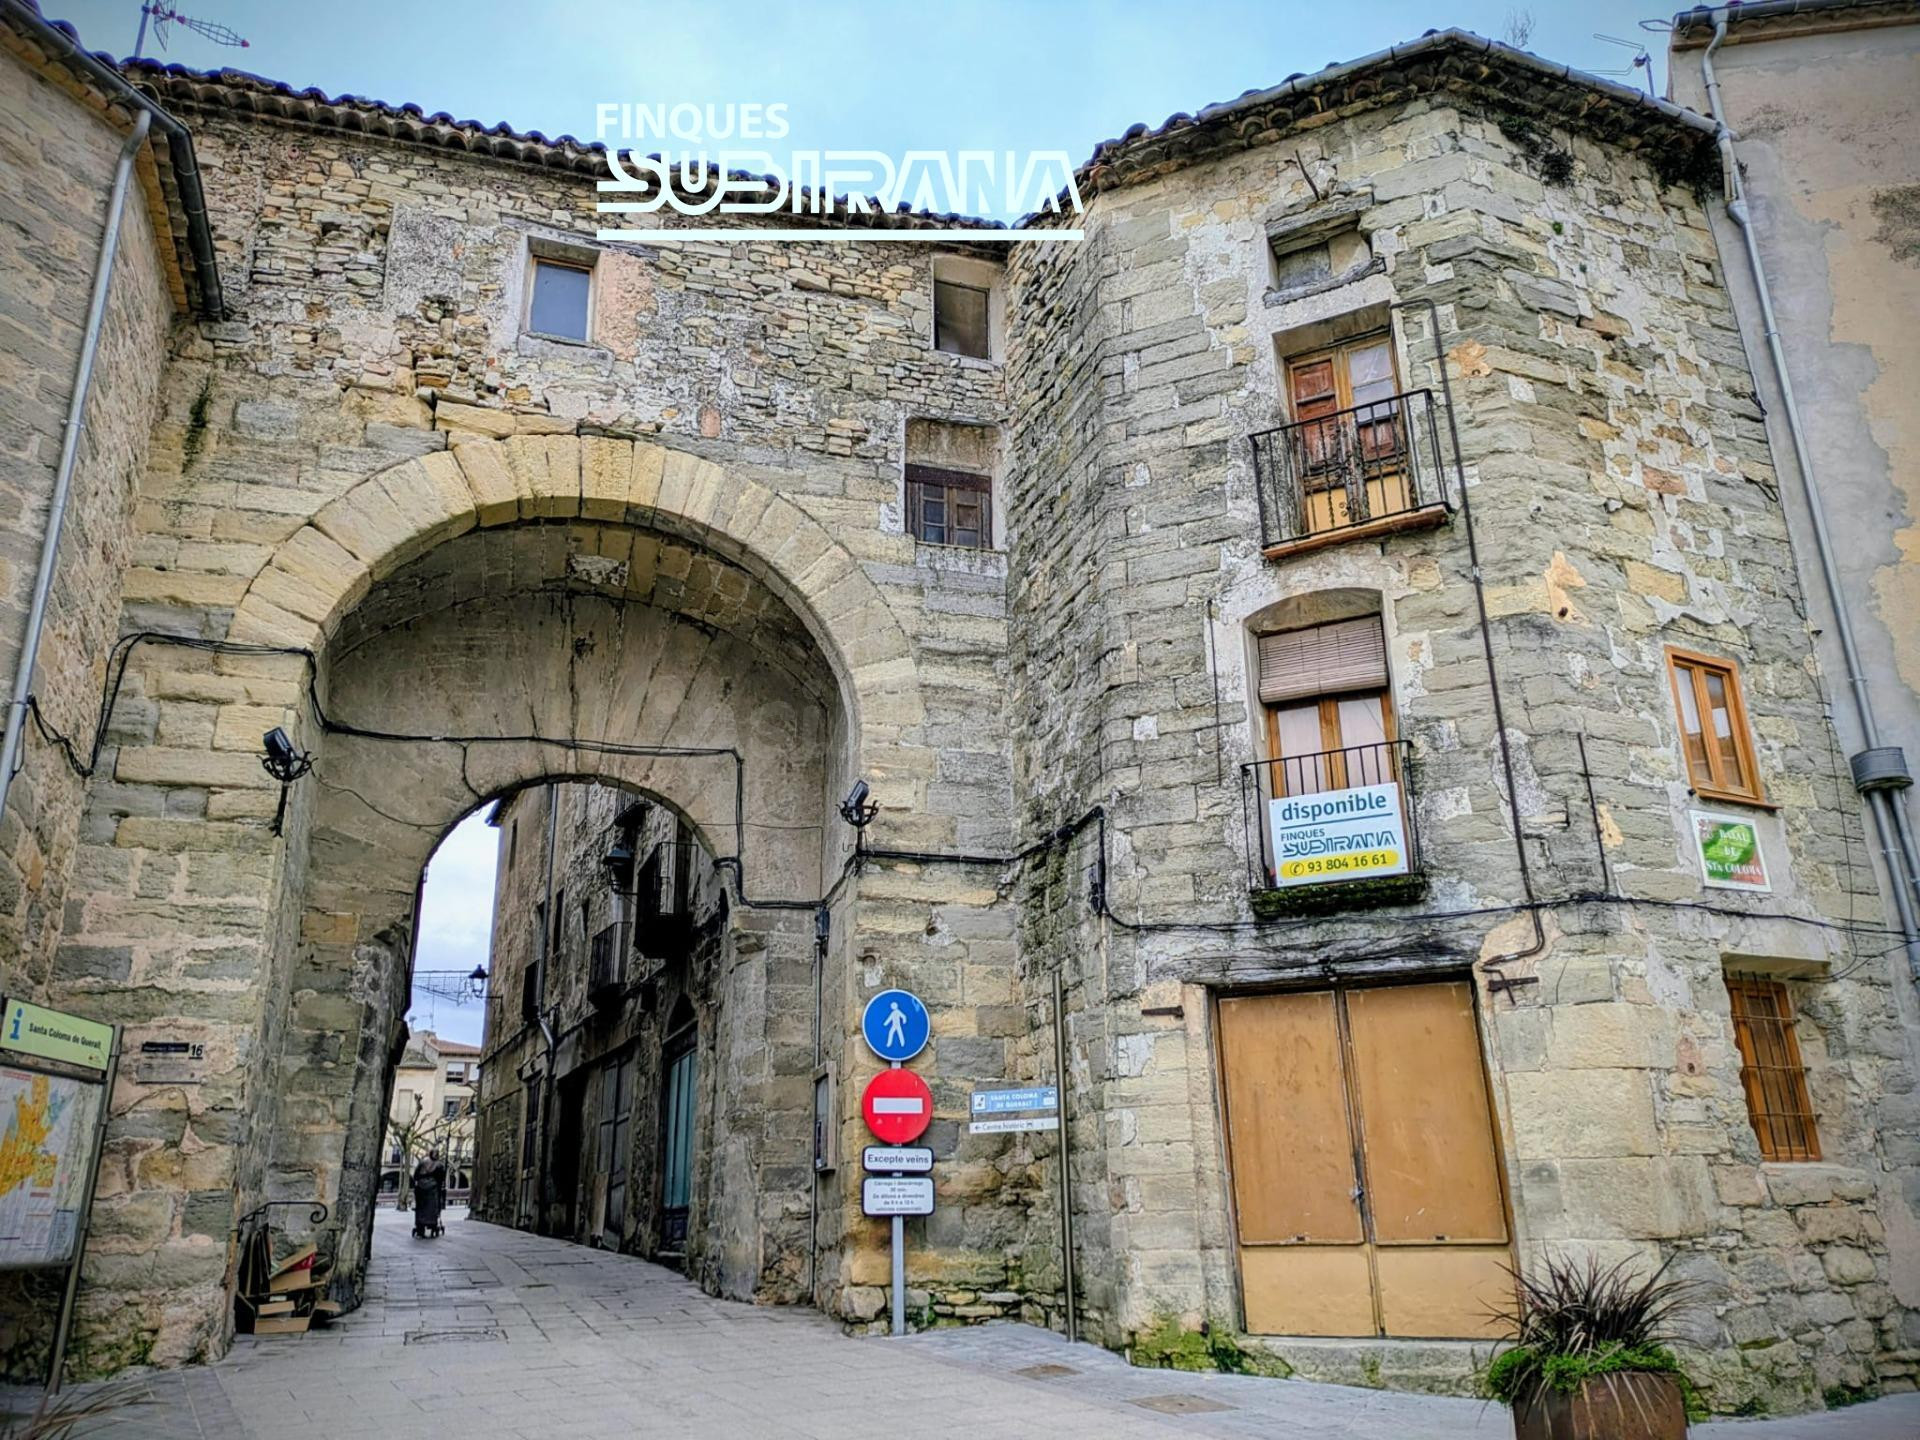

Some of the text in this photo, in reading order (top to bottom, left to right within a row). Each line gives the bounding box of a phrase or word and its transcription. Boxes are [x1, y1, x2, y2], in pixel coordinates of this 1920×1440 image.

[1281, 792, 1387, 821] disponible
[1281, 828, 1325, 842] FINQUES
[1282, 831, 1397, 858] SUBIRANA
[1308, 853, 1387, 873] 93 804 16 61
[29, 1022, 101, 1049] Santa Coloma de Queralt
[191, 1044, 204, 1056] 16
